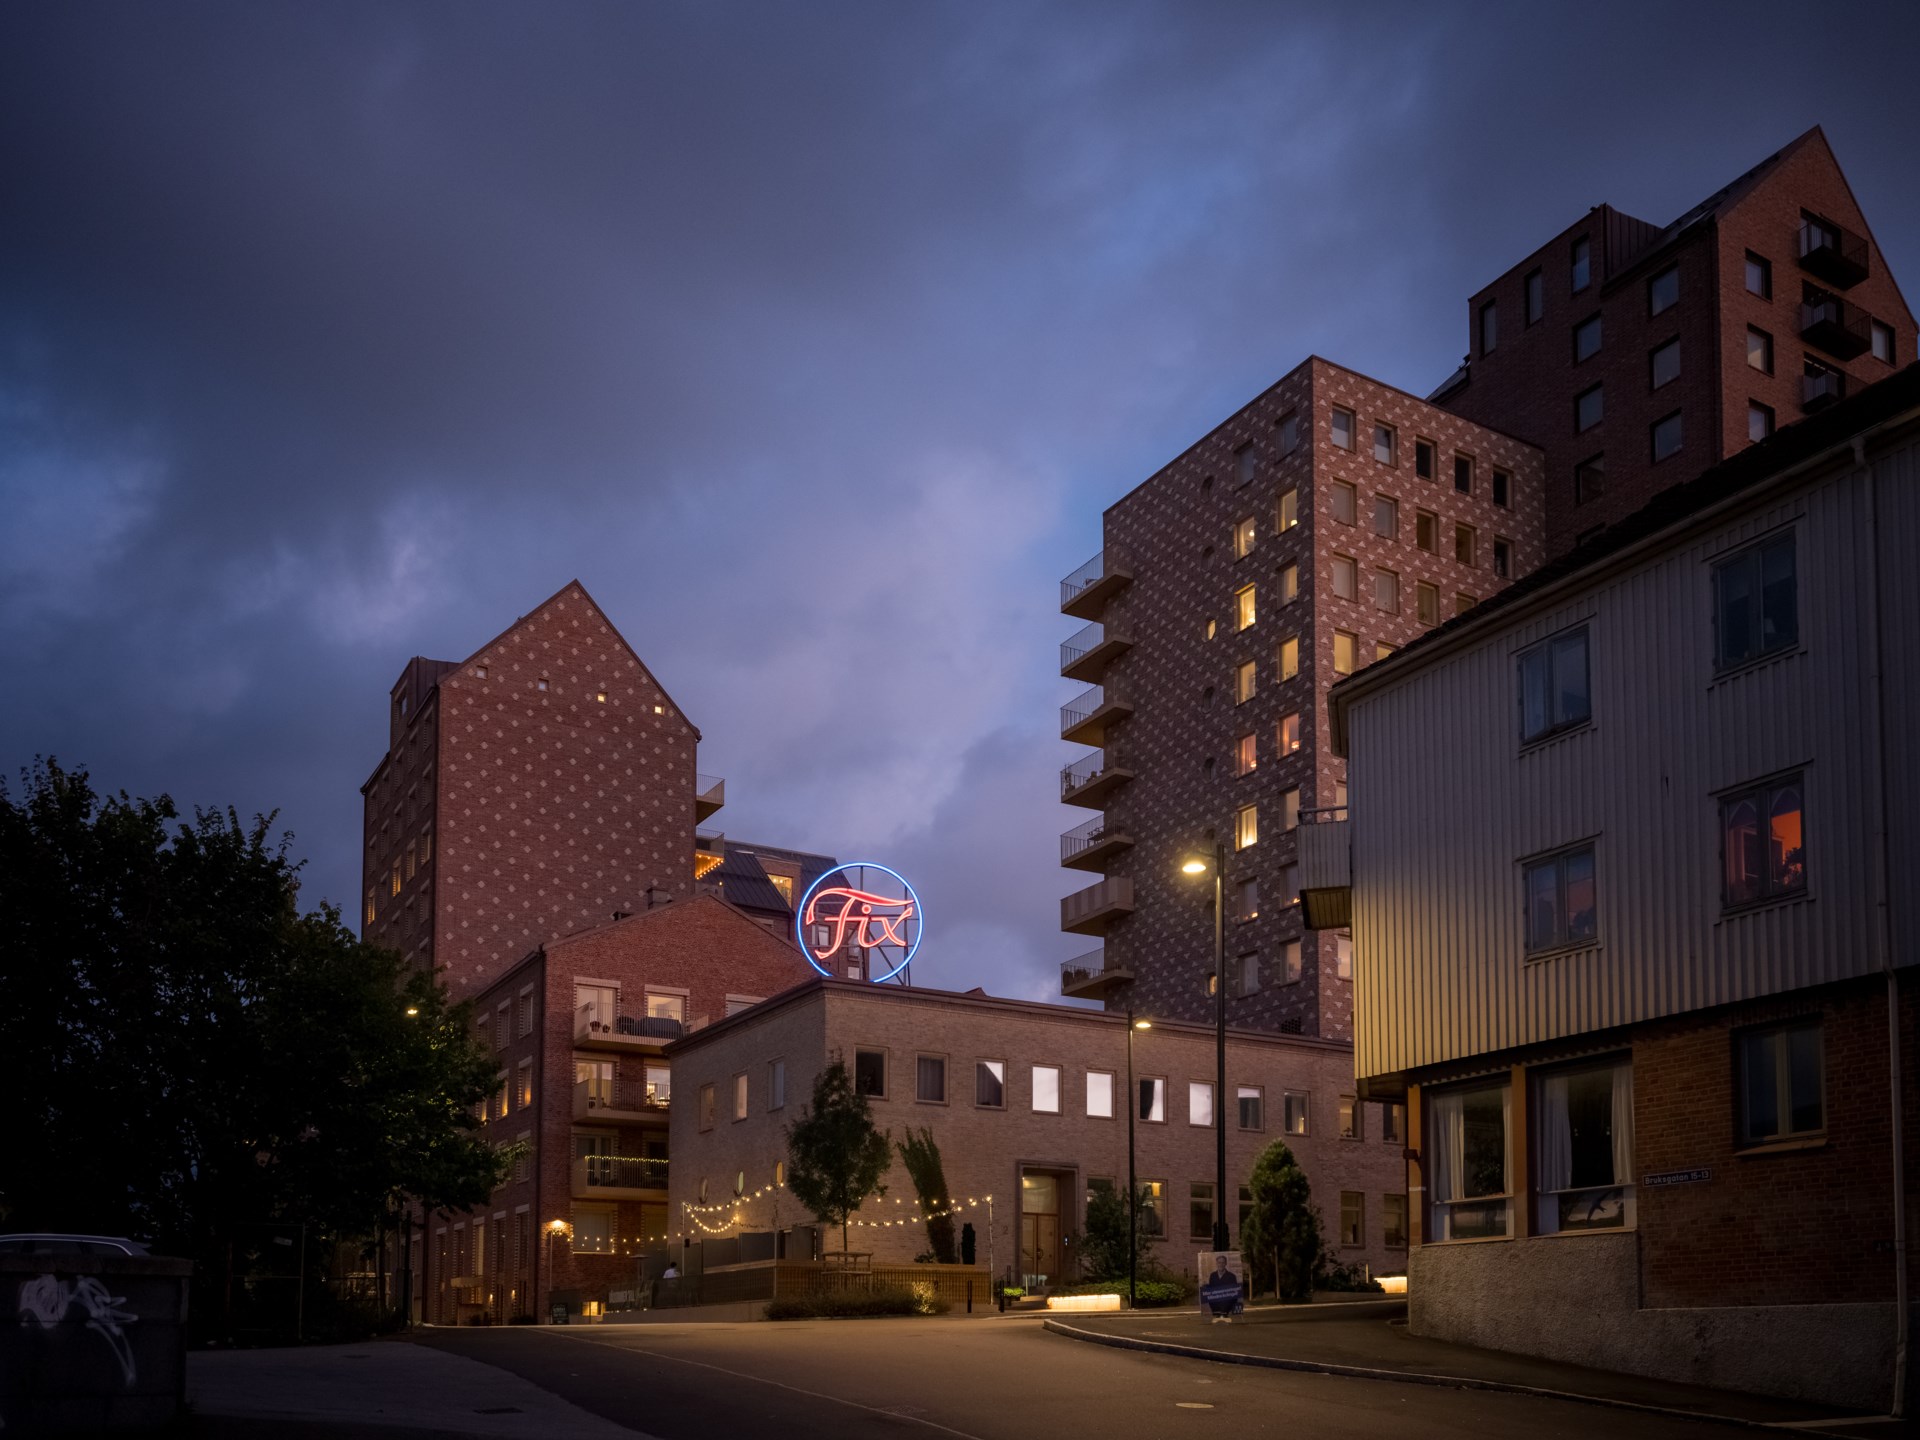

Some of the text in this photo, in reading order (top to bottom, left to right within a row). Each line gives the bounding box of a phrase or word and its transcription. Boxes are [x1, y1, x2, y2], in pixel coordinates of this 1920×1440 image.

[806, 887, 914, 960] Fix
[1645, 1171, 1709, 1185] Bruksgatan 15-13
